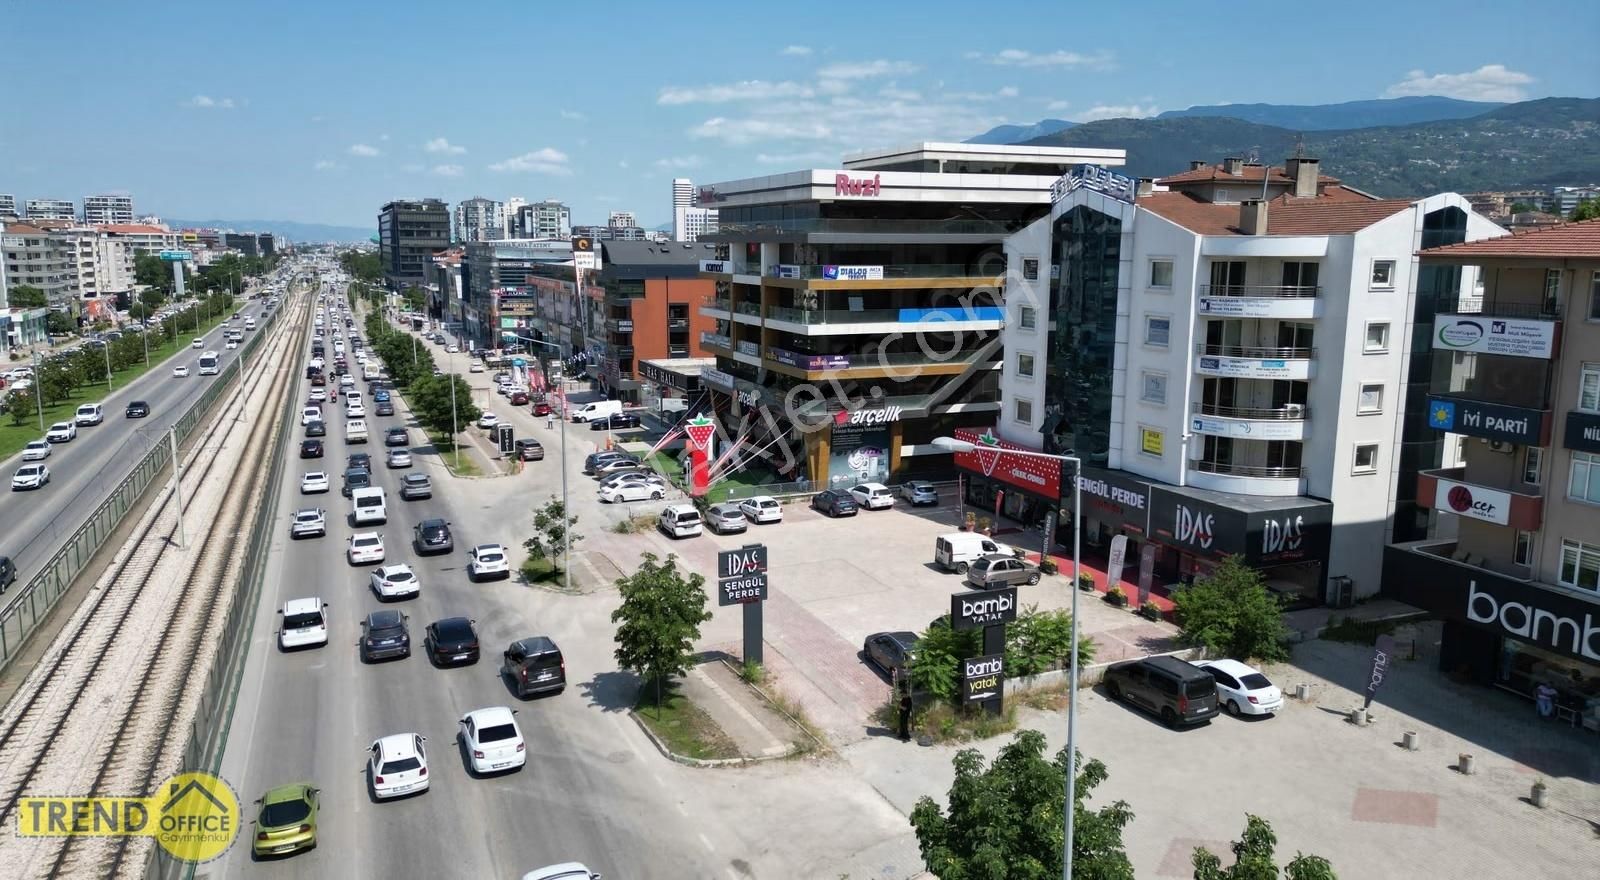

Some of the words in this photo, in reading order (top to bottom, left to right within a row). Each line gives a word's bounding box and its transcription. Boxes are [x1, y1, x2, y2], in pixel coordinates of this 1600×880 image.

[851, 405, 903, 427] arçelik
[1463, 409, 1481, 427] İYİ
[1485, 416, 1529, 435] PARTİ
[1111, 486, 1145, 509] PERDE
[725, 576, 764, 592] ŞENGÜL
[728, 588, 760, 600] PERDE
[962, 593, 1013, 617] bambi
[966, 657, 1003, 677] bambi
[969, 676, 997, 694] yatak
